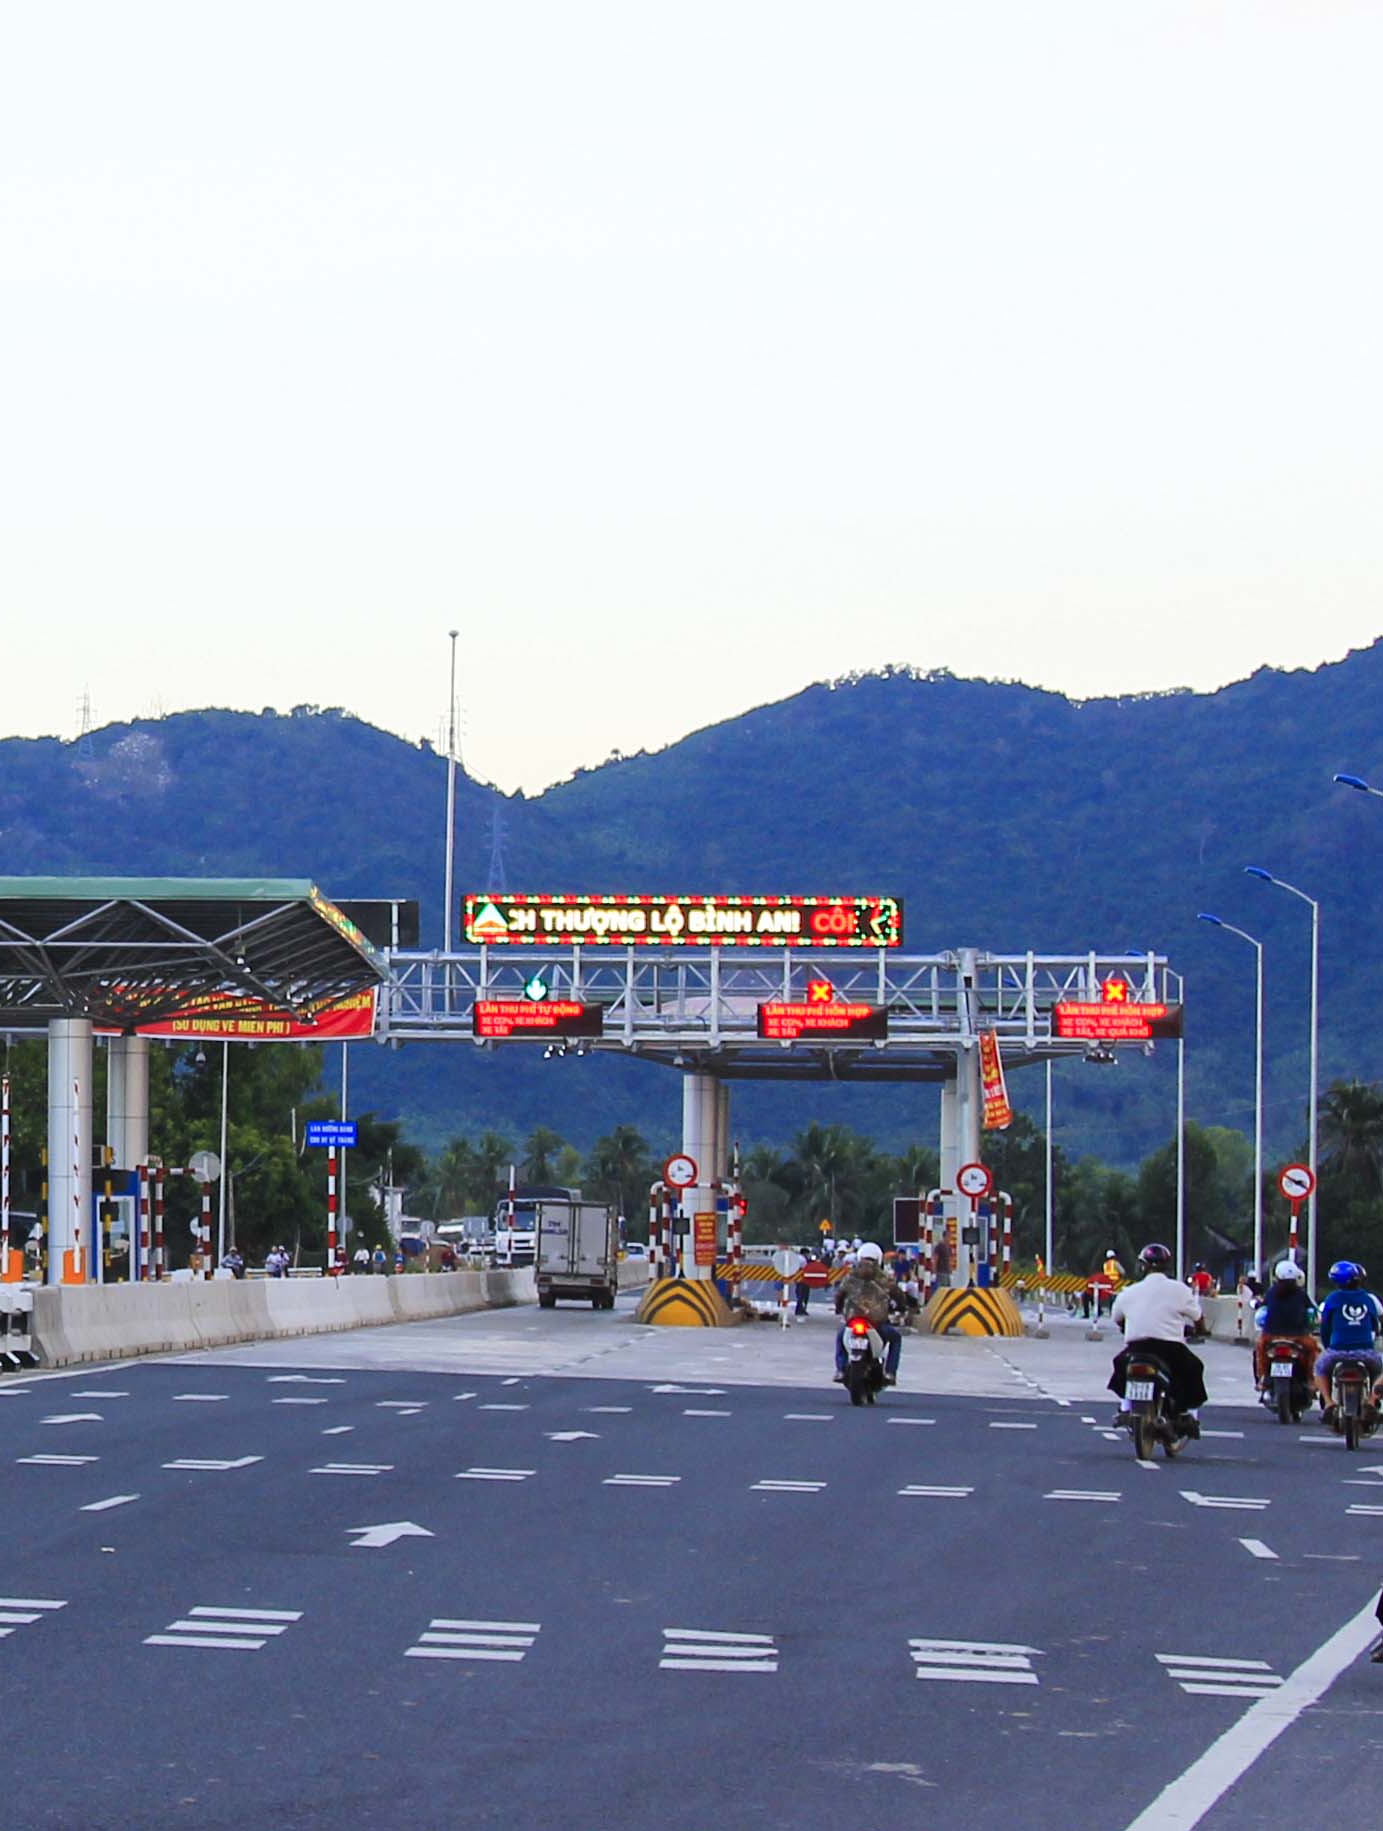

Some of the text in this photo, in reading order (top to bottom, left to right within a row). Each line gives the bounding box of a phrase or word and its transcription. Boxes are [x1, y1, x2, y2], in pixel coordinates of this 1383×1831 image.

[540, 907, 645, 935] THƯỢNG
[651, 904, 685, 936] LỘ
[688, 904, 753, 932] BÌNH
[756, 909, 801, 932] AN!
